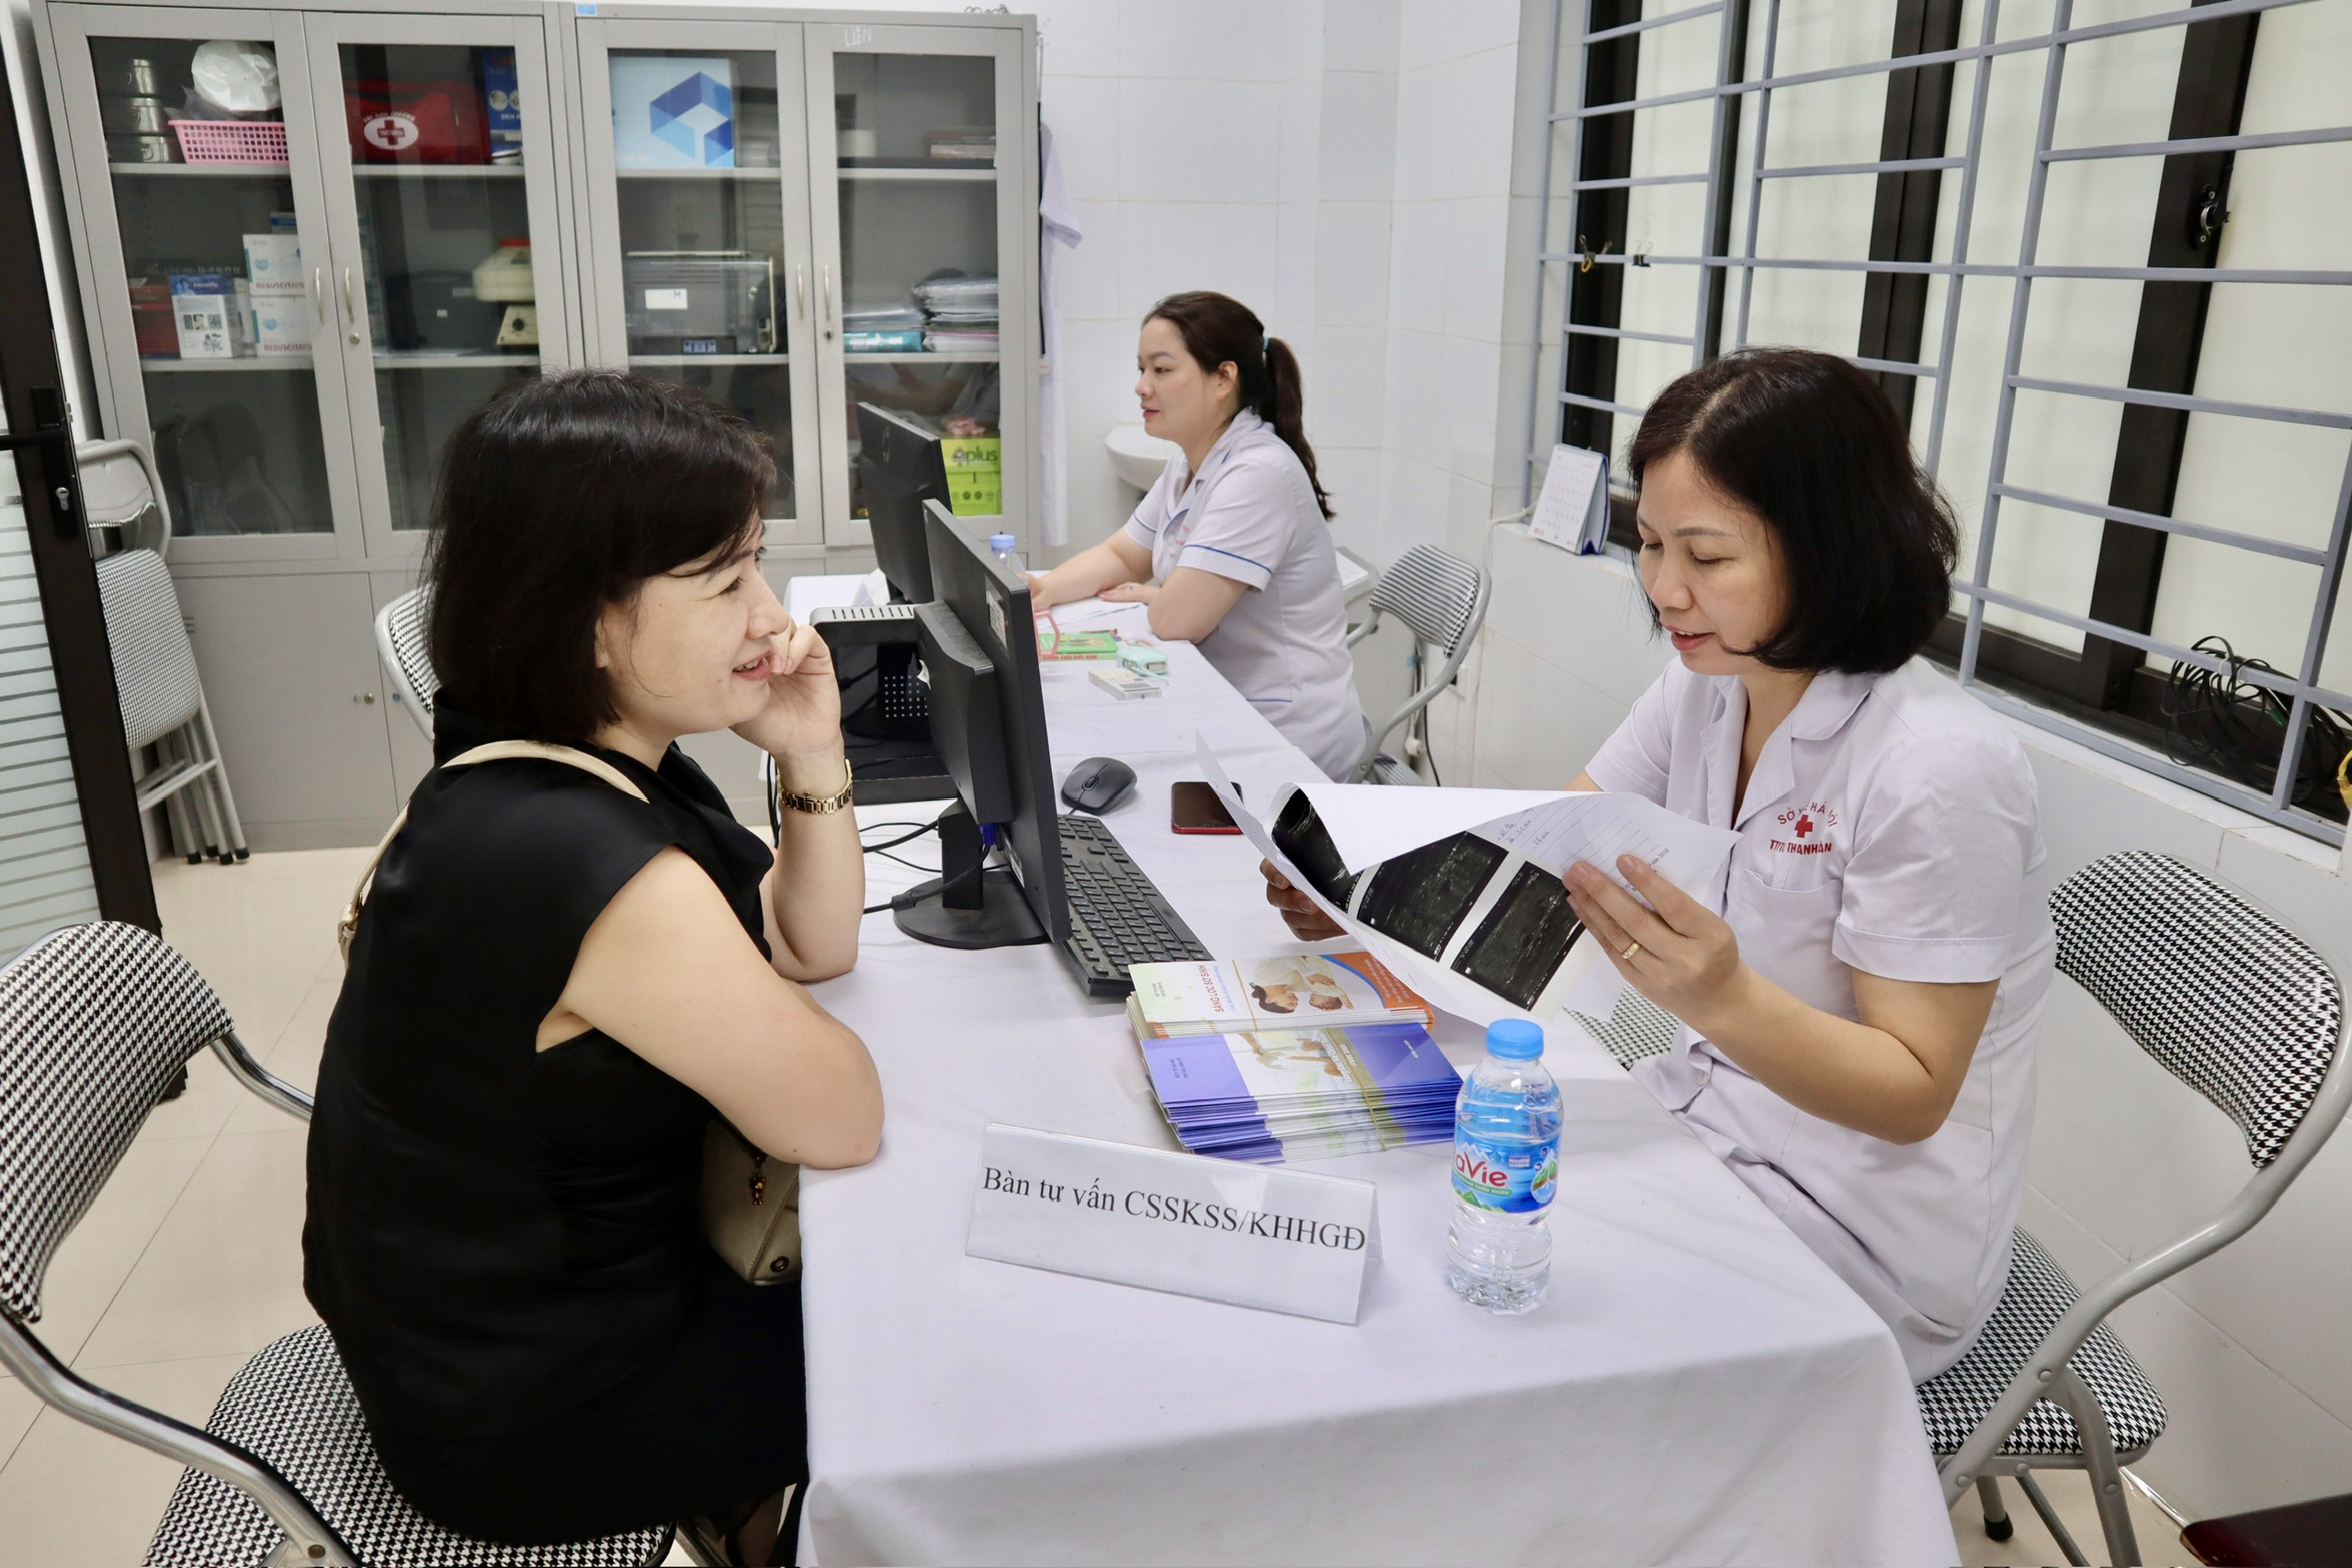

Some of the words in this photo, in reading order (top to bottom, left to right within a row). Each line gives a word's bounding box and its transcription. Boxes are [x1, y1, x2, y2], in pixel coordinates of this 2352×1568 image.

[982, 1166, 1031, 1197] Bàn
[1073, 1177, 1115, 1212] vấn
[1125, 1190, 1366, 1252] CSSKSS/KHHGĐ
